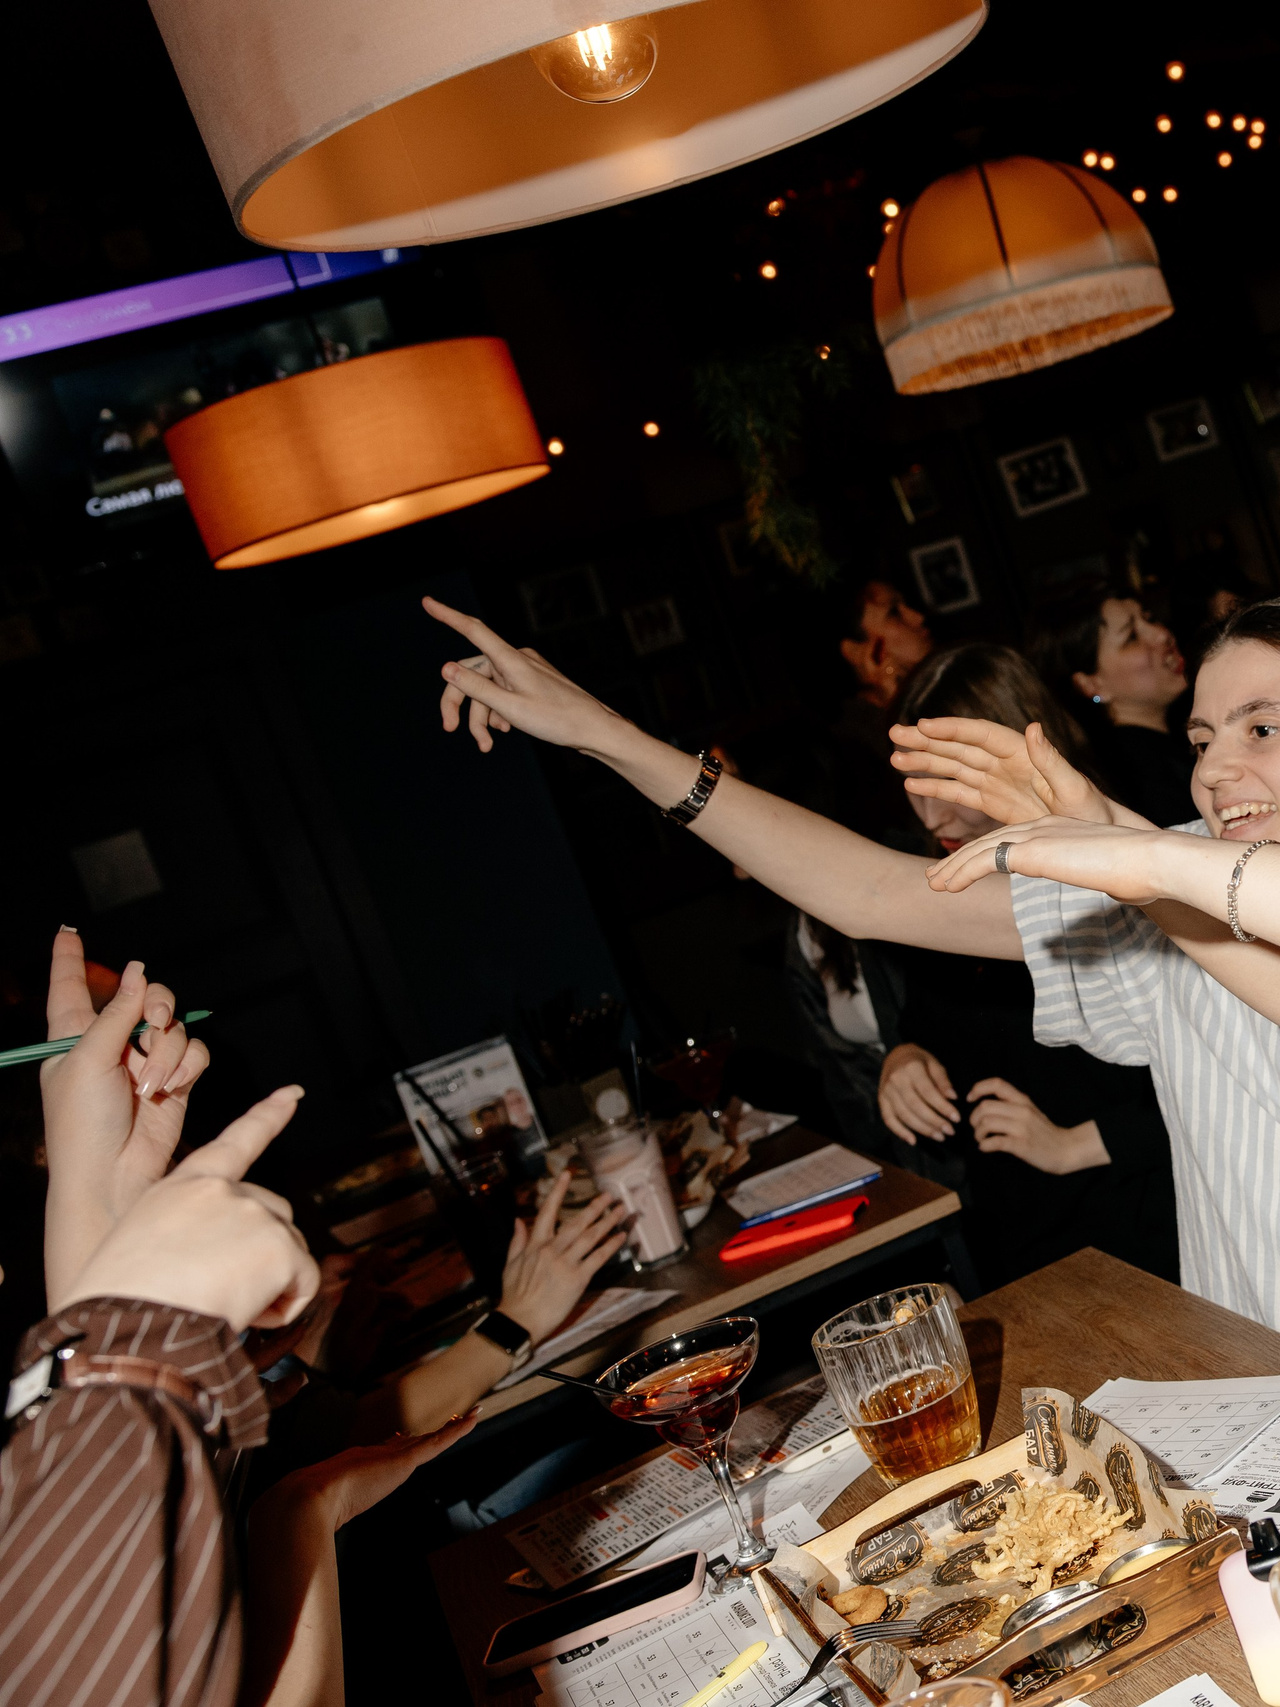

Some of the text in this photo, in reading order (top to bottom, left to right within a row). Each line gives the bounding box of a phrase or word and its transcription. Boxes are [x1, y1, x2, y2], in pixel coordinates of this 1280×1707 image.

[1025, 1429, 1038, 1456] БАР
[970, 1480, 995, 1501] БАР
[867, 1530, 893, 1551] БАР
[692, 1630, 702, 1639] 55
[769, 1658, 791, 1680] раунд
